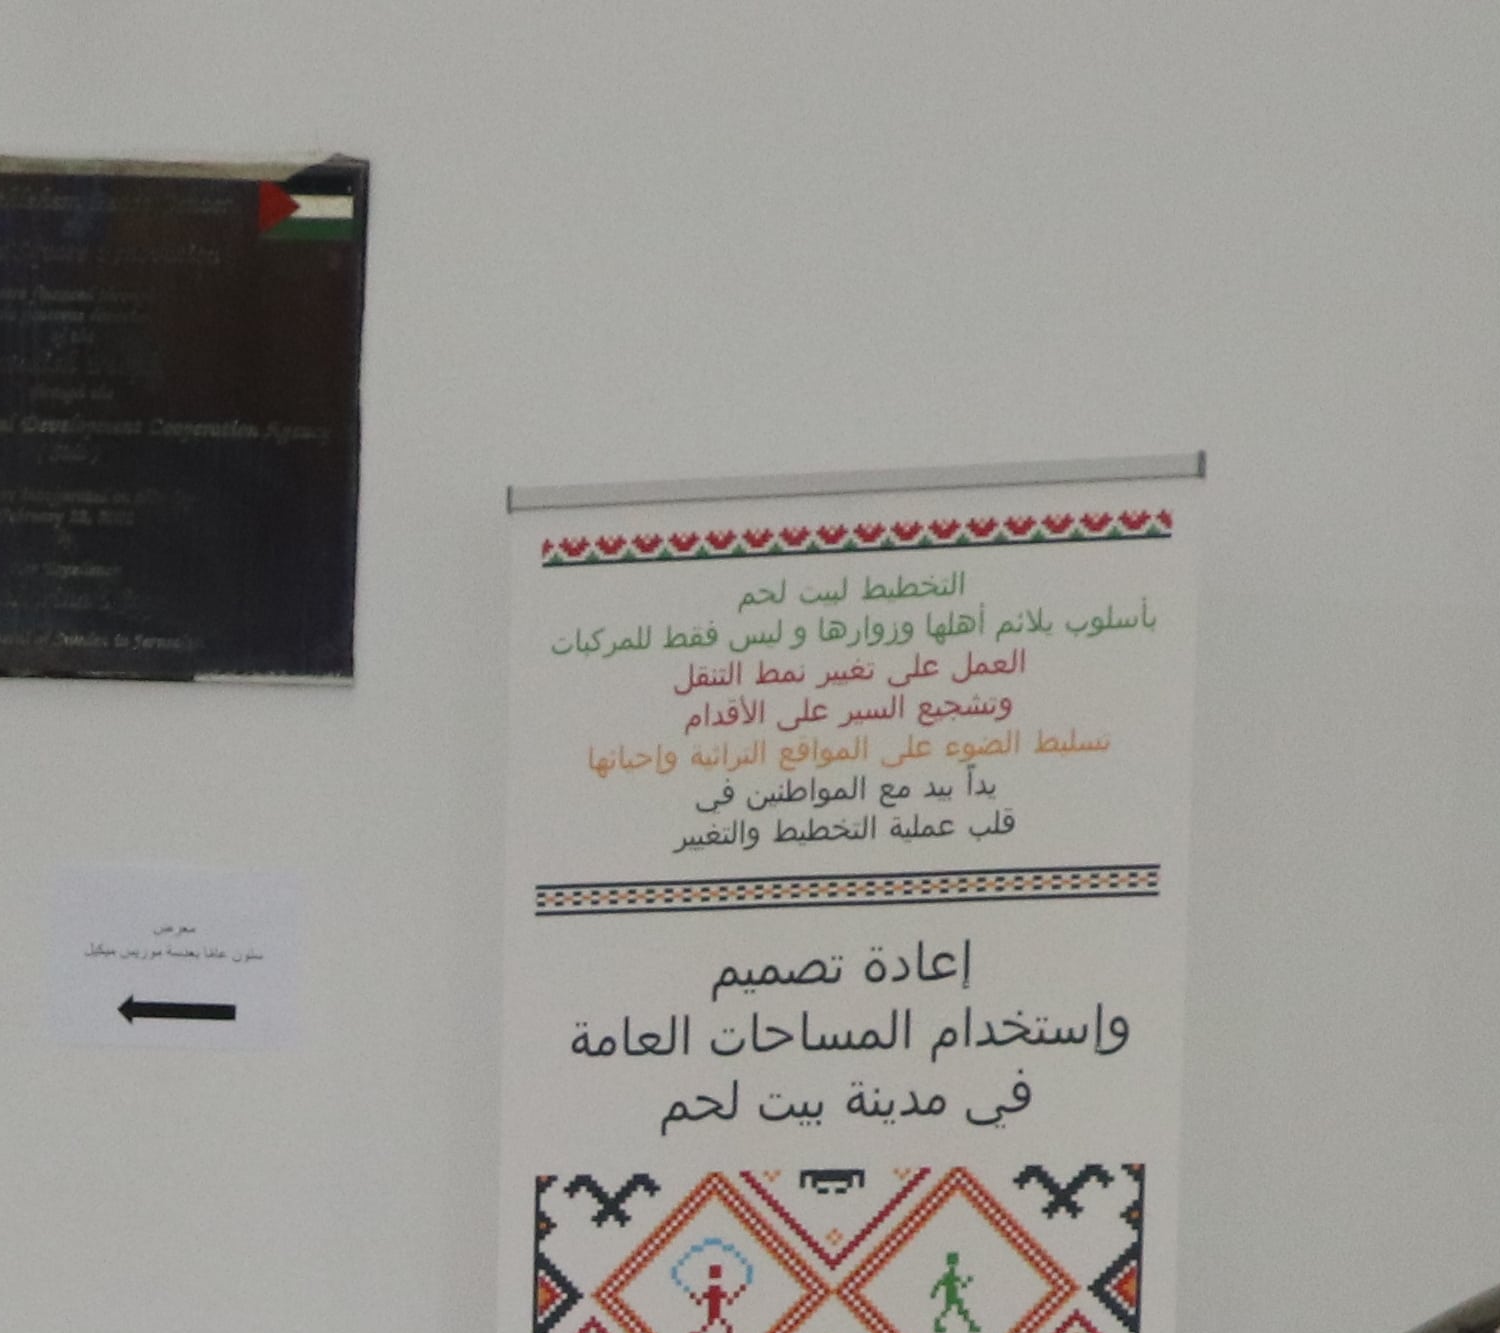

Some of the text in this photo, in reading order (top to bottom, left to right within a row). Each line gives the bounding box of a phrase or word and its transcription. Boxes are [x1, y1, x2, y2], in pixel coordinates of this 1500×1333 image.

[737, 570, 966, 615] التخطيط لبيت لحم
[663, 607, 719, 649] فقط
[817, 614, 915, 648] وزوارها
[925, 602, 985, 639] أهلها
[995, 607, 1054, 638] يلائم
[1064, 596, 1158, 636] بأسلوب
[550, 624, 653, 660] للمركبات
[728, 618, 783, 655] ليس
[673, 647, 1026, 696] العمل على تغيير نمط التنقل
[683, 694, 1014, 736] وتشجيع السير على الأقدام
[777, 735, 869, 772] المواقع
[880, 733, 933, 770] على
[944, 729, 1021, 763] الضوء
[1033, 729, 1111, 757] تسليط
[695, 779, 736, 814] في
[746, 774, 867, 812] المواطنين
[878, 784, 911, 809] مع
[922, 781, 953, 801] بيد
[671, 811, 1016, 855] قلب عملية التخطيط والتغيير
[710, 938, 971, 1003] إعادة تصميم
[570, 1014, 691, 1058] العامة
[709, 1007, 912, 1058] المساحات
[660, 1068, 1032, 1138] في مدينة بيت لحم
